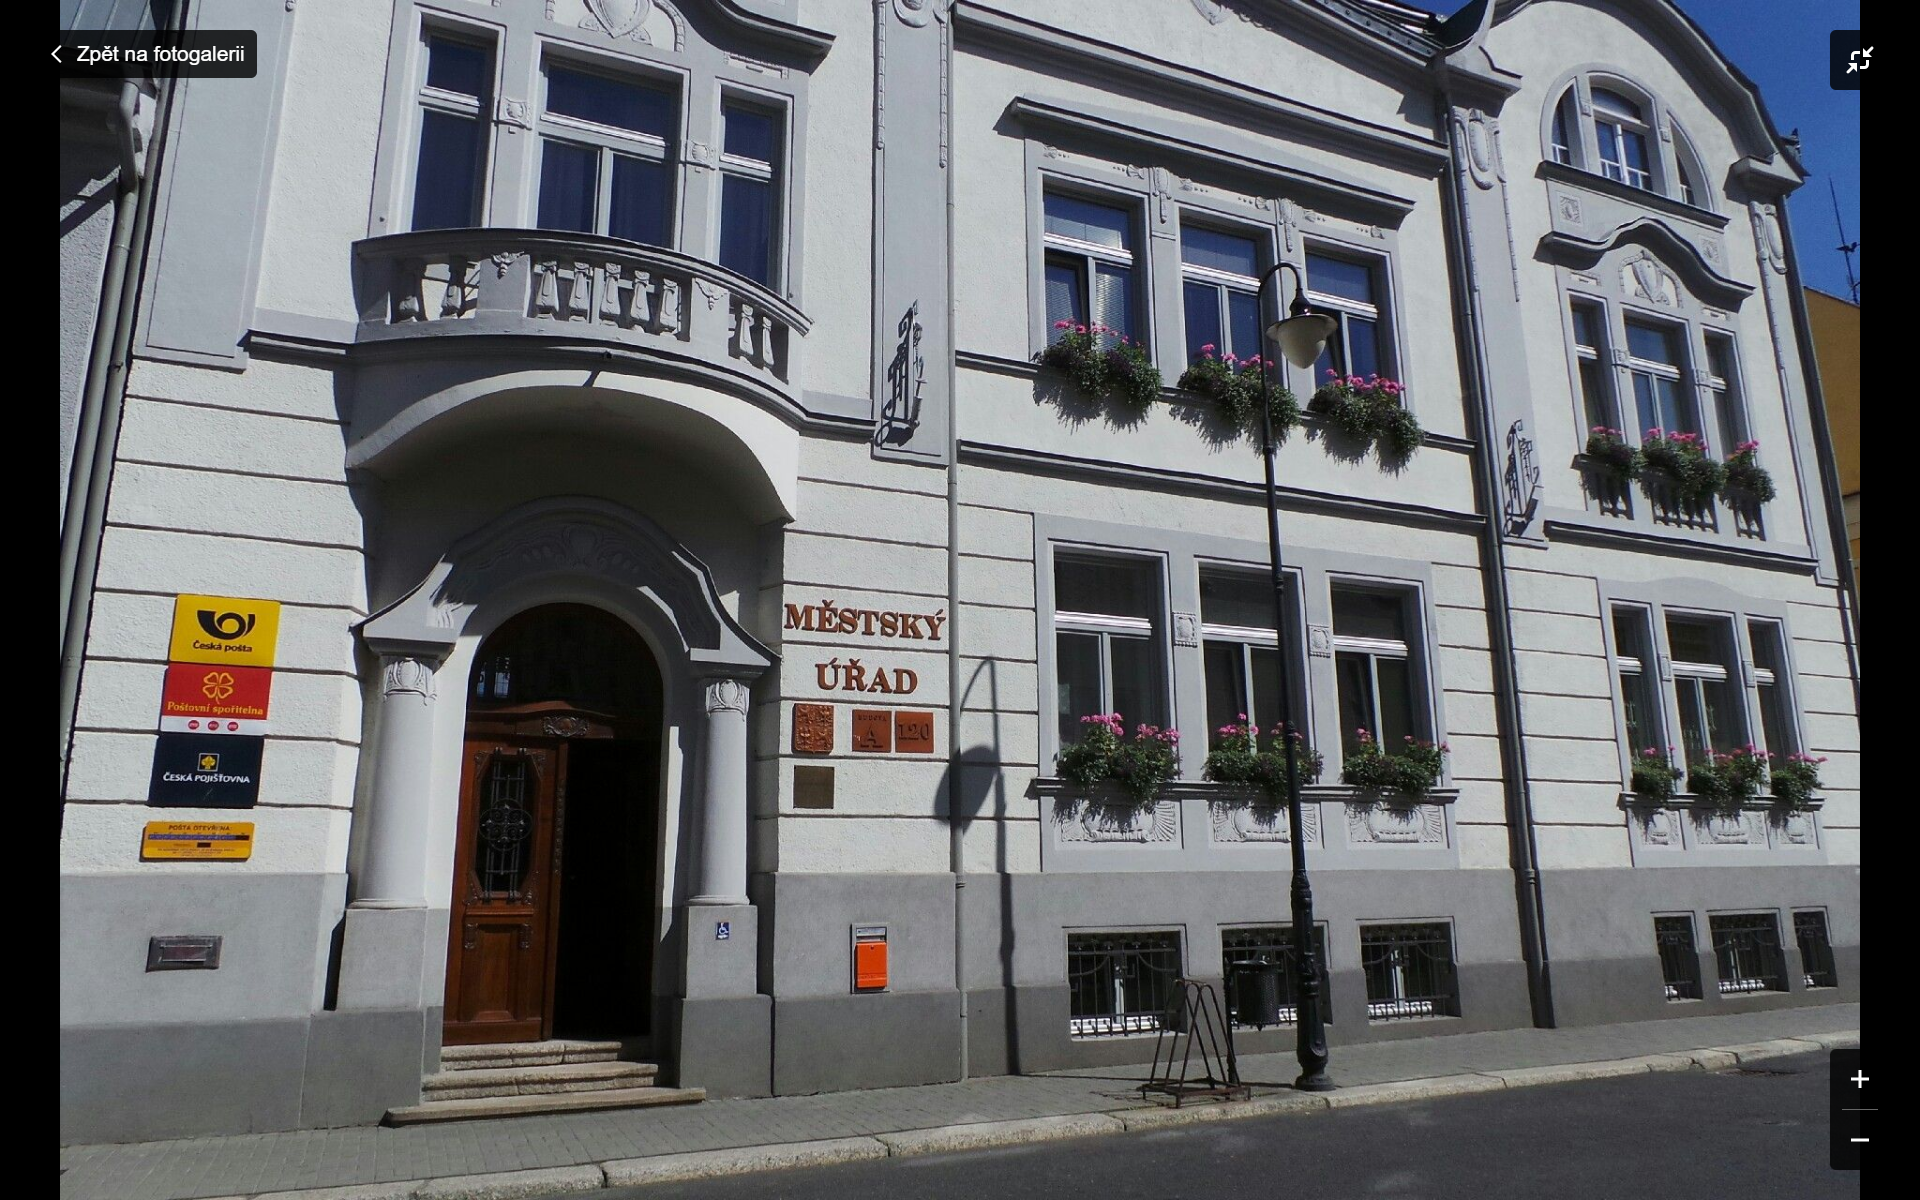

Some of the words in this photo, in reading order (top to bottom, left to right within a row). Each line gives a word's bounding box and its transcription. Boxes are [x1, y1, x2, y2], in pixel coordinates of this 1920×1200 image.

[784, 600, 946, 640] MĚSTSKÝ
[193, 640, 222, 651] Česká
[224, 643, 253, 653] pošta
[815, 658, 918, 694] ÚŘAD
[167, 701, 210, 712] Poštovní
[212, 704, 263, 715] spořitelna
[163, 772, 193, 782] ČESKÁ
[194, 773, 250, 783] POJIŠŤOVNA
